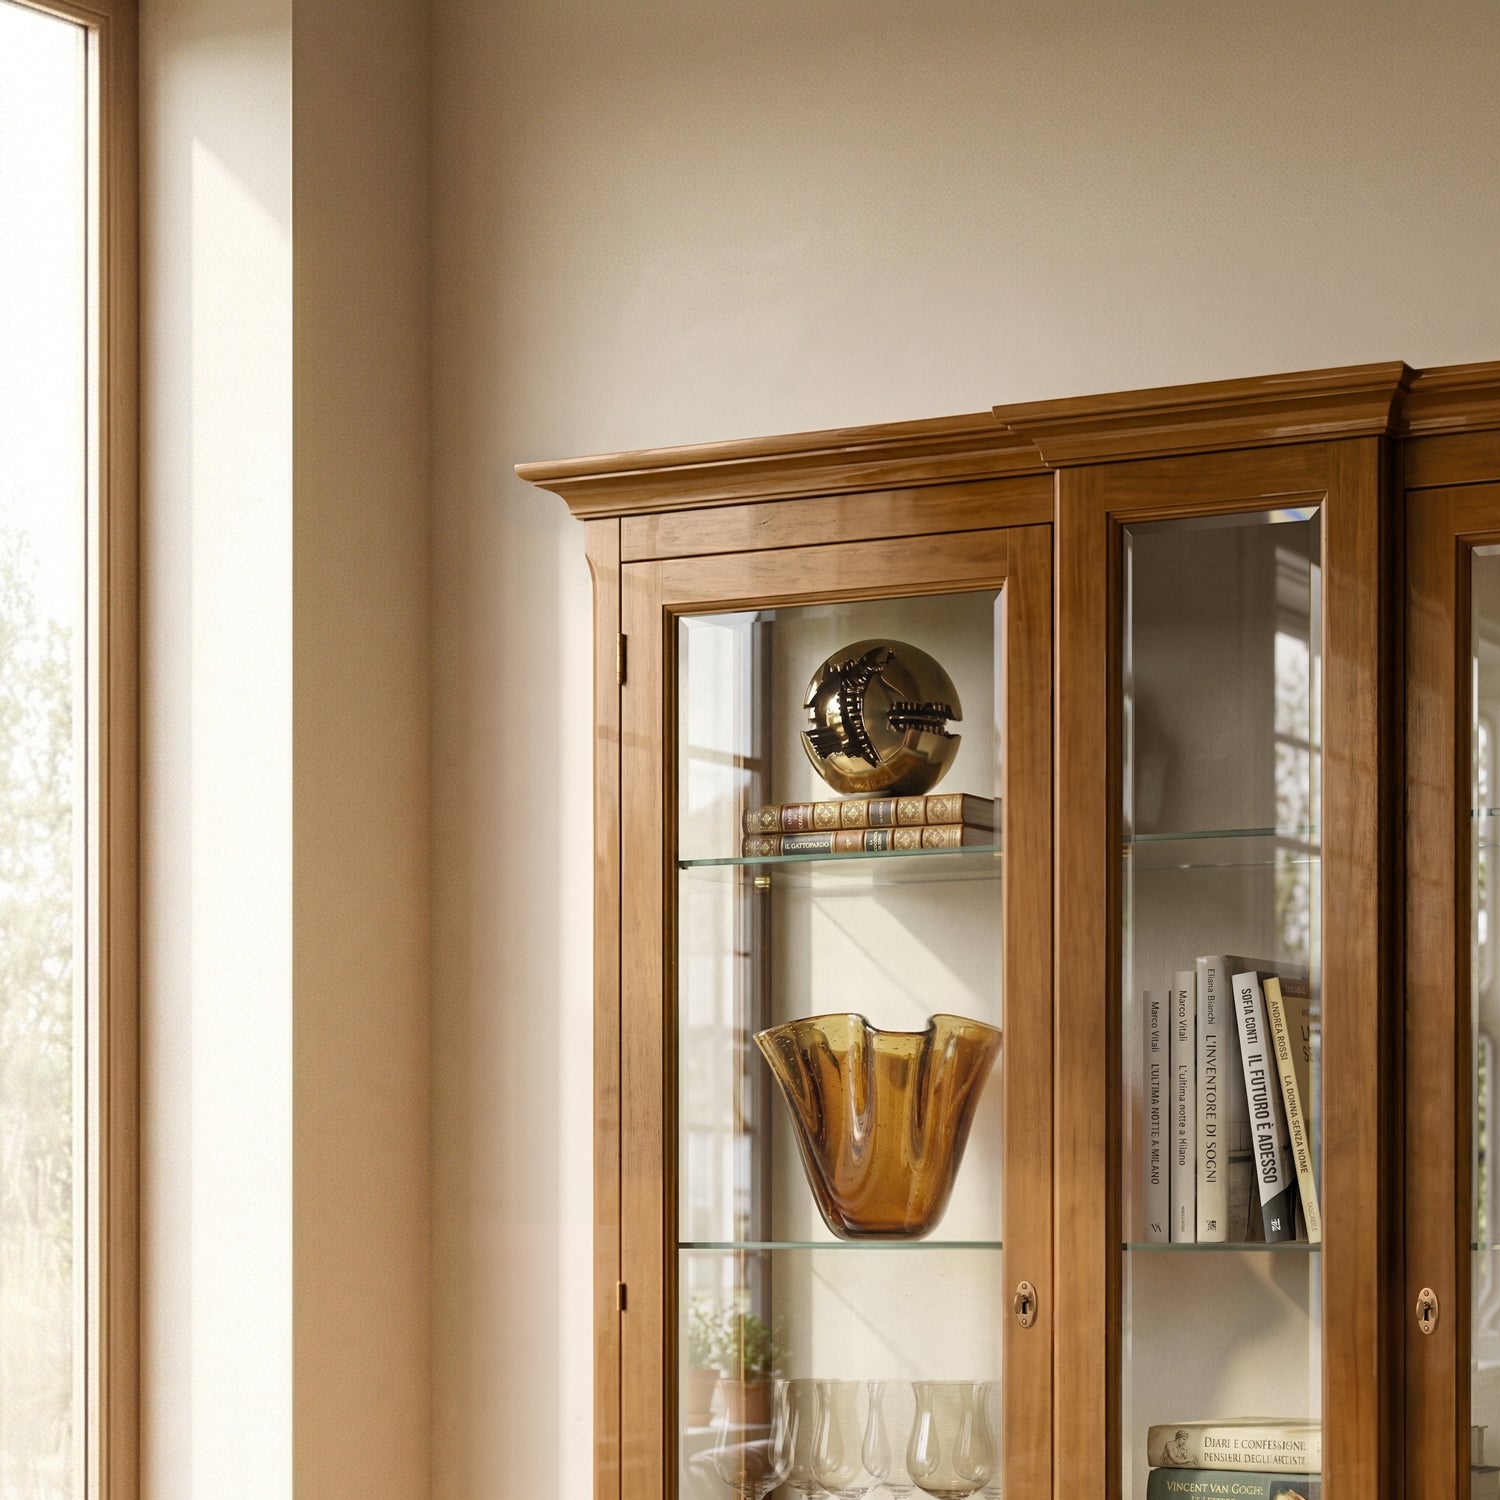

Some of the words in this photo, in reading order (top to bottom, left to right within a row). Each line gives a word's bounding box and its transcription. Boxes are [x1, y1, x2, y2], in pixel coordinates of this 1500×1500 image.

[790, 841, 829, 849] GATTOPARDO
[1207, 968, 1216, 993] Eliana
[1151, 1001, 1160, 1028] Marco
[1178, 990, 1188, 1018] Marco
[1207, 995, 1216, 1025] Bianchi
[1241, 988, 1254, 1016] SOFIA
[1151, 1030, 1160, 1053] Vitali
[1178, 1019, 1188, 1042] Vitali
[1244, 1016, 1258, 1044] CONTI
[1270, 1001, 1283, 1034] ANDREA
[1277, 1035, 1288, 1061] ROSSI
[1247, 1054, 1262, 1067] IL
[1150, 1063, 1160, 1105] L'ULTIMA
[1178, 1065, 1188, 1102] L'ultima
[1205, 1035, 1216, 1120] L'INVENTORE
[1284, 1075, 1292, 1087] LA
[1249, 1069, 1270, 1120] FUTURO
[1286, 1088, 1298, 1118] DONNA
[1150, 1107, 1160, 1138] NOTTE
[1178, 1104, 1187, 1128] notte
[1256, 1122, 1274, 1131] È
[1205, 1124, 1216, 1137] DI
[1291, 1119, 1302, 1148] SENZA
[1205, 1141, 1216, 1182] SOGNI
[1257, 1134, 1278, 1184] ADESSO
[1297, 1149, 1308, 1174] NOME
[1204, 1436, 1230, 1449] DIARI
[1233, 1438, 1239, 1449] E
[1204, 1452, 1241, 1463] PENSIERI
[1244, 1453, 1271, 1464] DEGLI
[1272, 1454, 1306, 1466] ARTISTI
[1166, 1480, 1208, 1493] VINCENT
[1210, 1483, 1229, 1494] VAN
[1231, 1483, 1264, 1496] GOGH:
